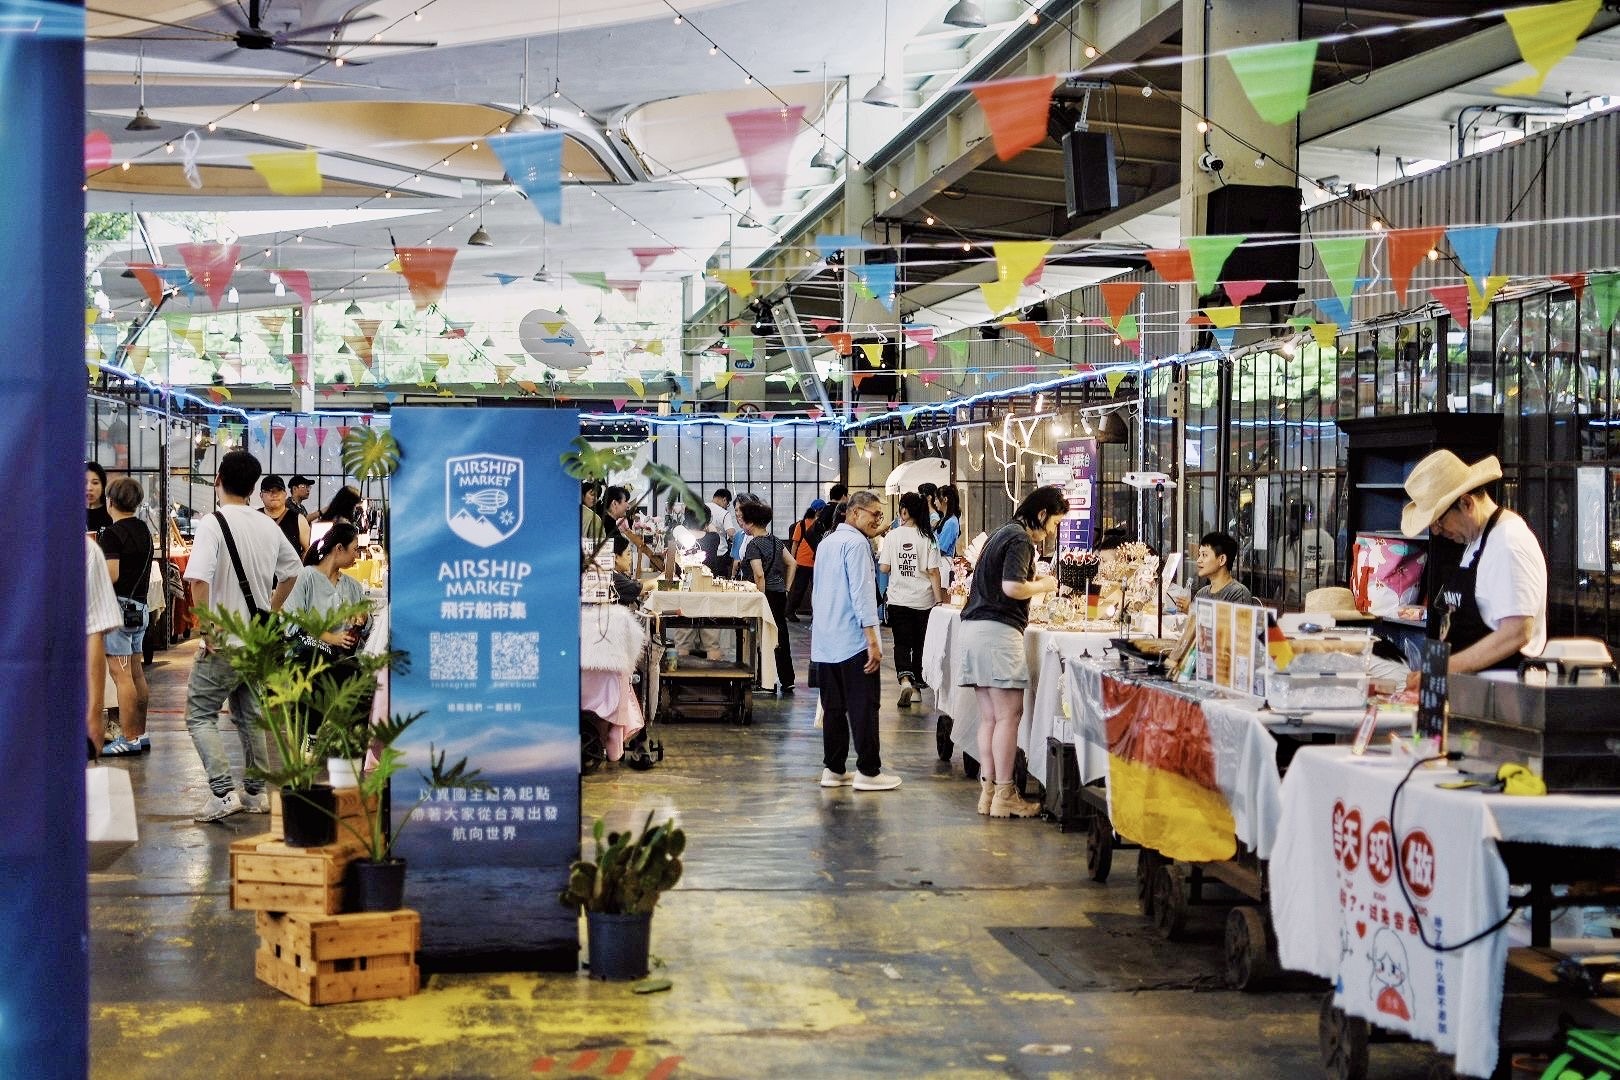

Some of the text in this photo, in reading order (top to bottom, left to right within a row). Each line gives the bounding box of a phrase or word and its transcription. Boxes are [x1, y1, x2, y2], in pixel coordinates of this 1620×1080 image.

[454, 461, 517, 475] AIRSHIP
[459, 475, 512, 487] MARKET
[898, 552, 917, 560] LOVE
[438, 559, 532, 581] AIRSHIP
[446, 581, 523, 597] MARKET
[440, 602, 527, 620] 飛行船市集
[419, 786, 551, 802] 以異國主題為起點
[411, 806, 559, 822] 帶著大家從台灣出發
[452, 826, 517, 841] 航向世界
